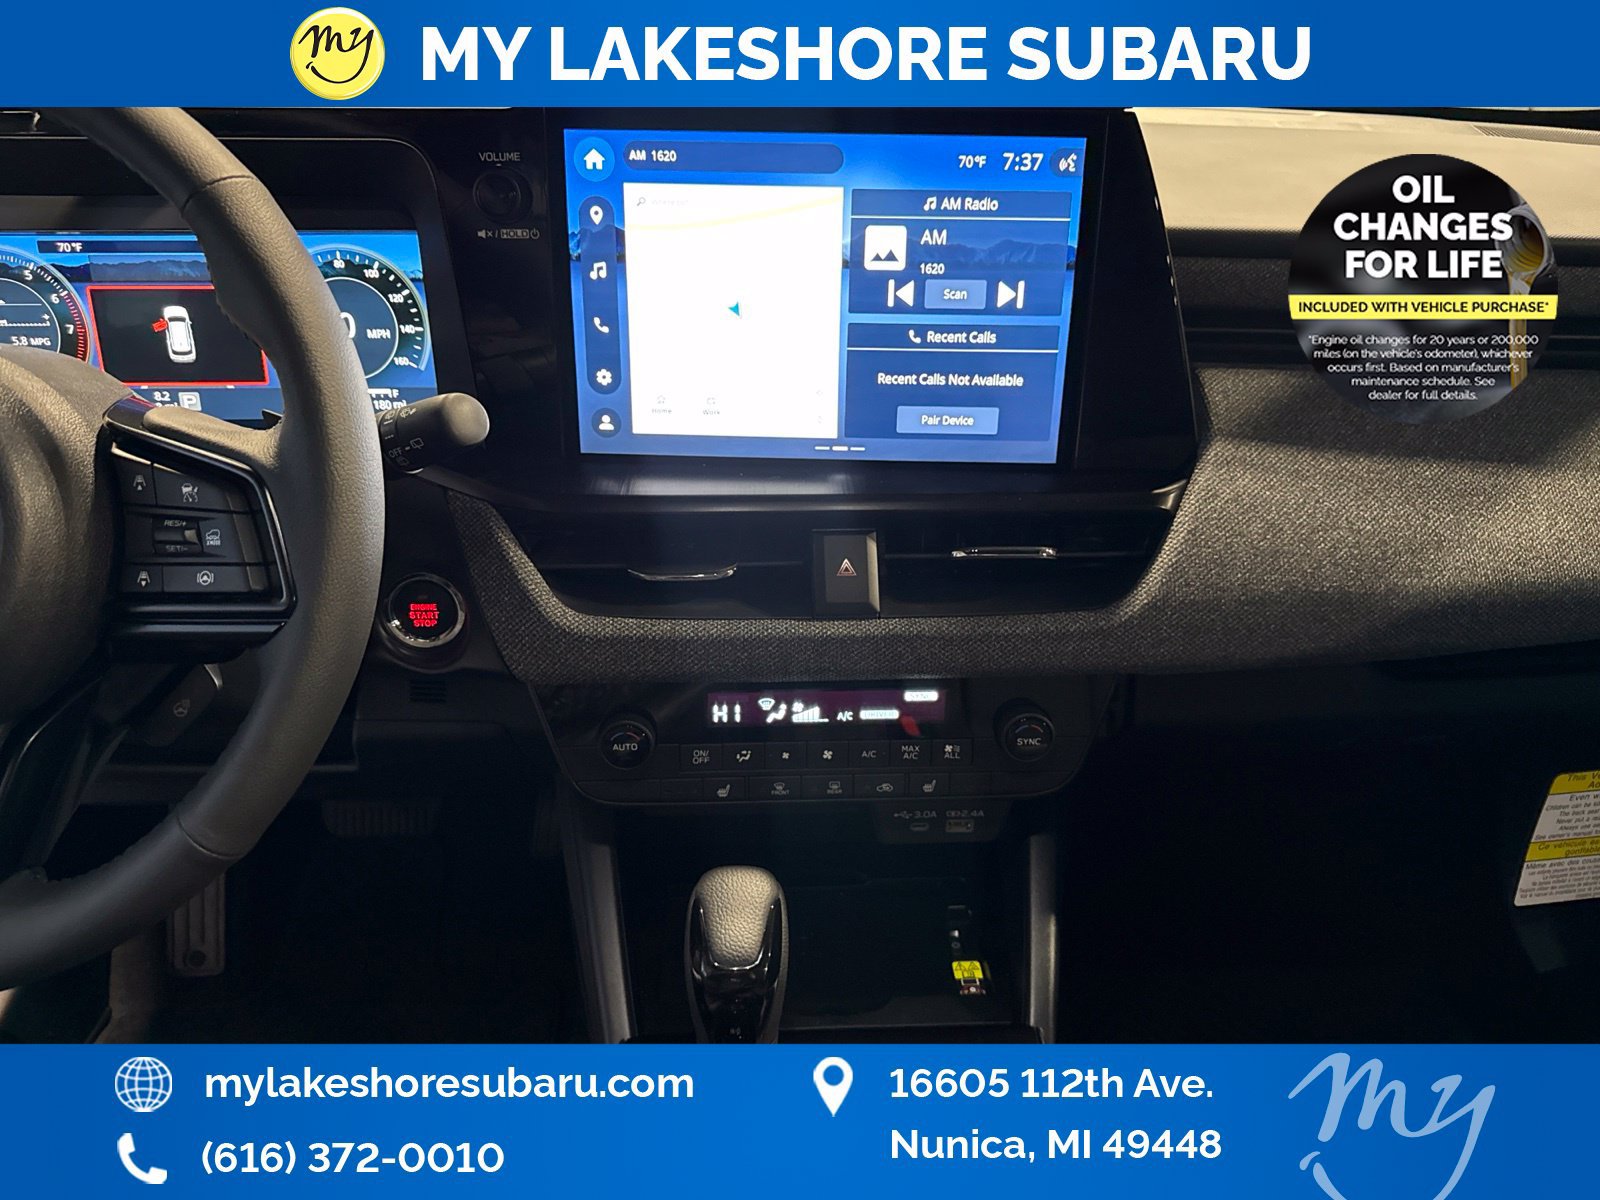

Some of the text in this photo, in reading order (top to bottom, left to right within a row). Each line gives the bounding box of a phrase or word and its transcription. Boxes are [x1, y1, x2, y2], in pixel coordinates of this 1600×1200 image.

[479, 152, 520, 162] VOLUME
[628, 150, 677, 162] AM 1620
[1003, 152, 1044, 172] 7:37
[941, 197, 999, 211] AM Radio
[501, 229, 528, 239] HOLD
[920, 229, 947, 246] AM
[333, 259, 345, 268] 80
[364, 269, 379, 279] 100
[920, 263, 945, 275] 1620
[24, 269, 33, 281] 5
[51, 293, 60, 304] 6
[388, 294, 404, 303] 120
[943, 289, 967, 300] Scan
[67, 324, 74, 335] 7
[366, 329, 391, 340] MPH
[400, 325, 415, 334] 140
[11, 336, 51, 346] 5.8 MPG
[927, 330, 997, 344] Recent Calls
[877, 373, 1024, 387] Recent Calls Not Available
[153, 391, 171, 402] 8.2
[184, 394, 198, 409] P
[373, 400, 392, 410] 180
[921, 415, 974, 426] Pair Device
[388, 446, 402, 458] OFF
[410, 603, 437, 611] ENGINE
[409, 611, 439, 619] START
[837, 711, 853, 721] A/C
[612, 743, 638, 751] AUTO
[1016, 738, 1042, 746] SYNC
[693, 749, 709, 757] ON/
[903, 752, 918, 760] A/C
[1567, 773, 1587, 782] This
[1569, 794, 1590, 802] Even
[914, 810, 937, 818] 3.0A
[1538, 842, 1550, 851] Ce
